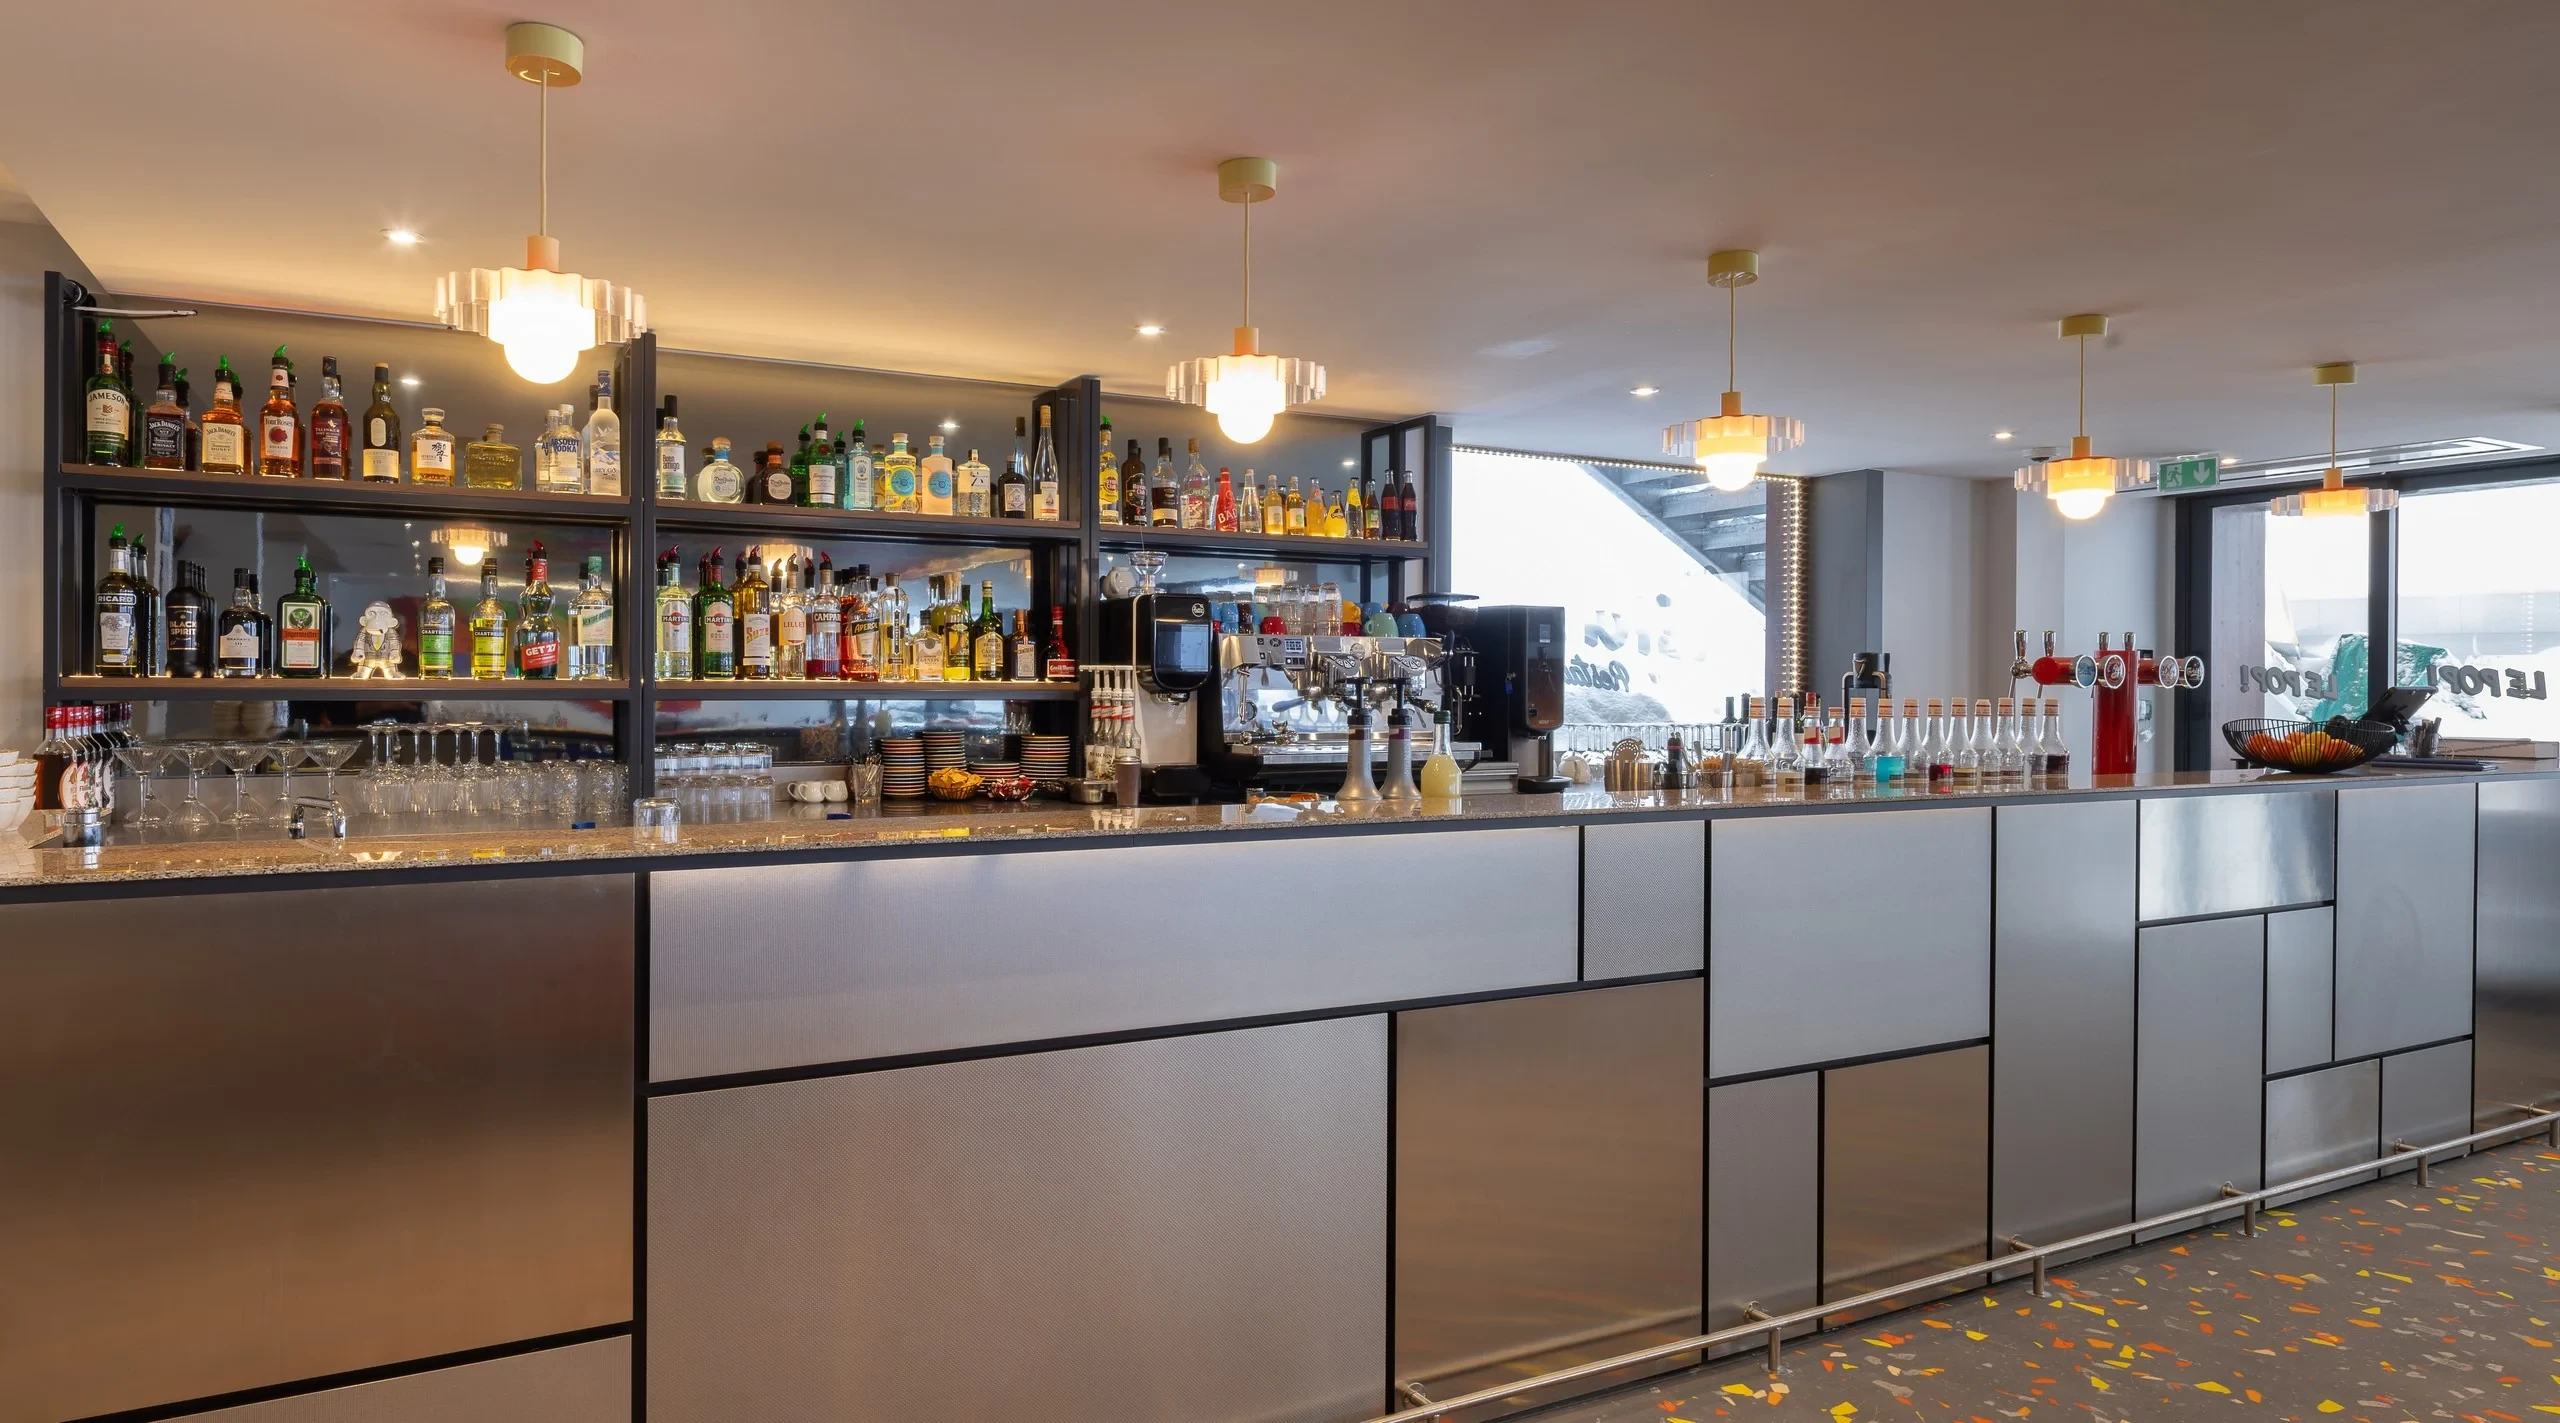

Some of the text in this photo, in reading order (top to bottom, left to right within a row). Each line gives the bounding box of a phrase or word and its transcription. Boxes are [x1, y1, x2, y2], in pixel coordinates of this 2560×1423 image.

[88, 392, 126, 405] JAMESON
[149, 421, 161, 430] JACK
[206, 427, 218, 436] JACK
[551, 438, 580, 446] ABSOLUT
[553, 444, 577, 453] VODKA
[662, 462, 680, 471] amigo
[97, 595, 134, 603] RICARD
[854, 622, 879, 633] APEROL
[525, 643, 557, 656] GET 27
